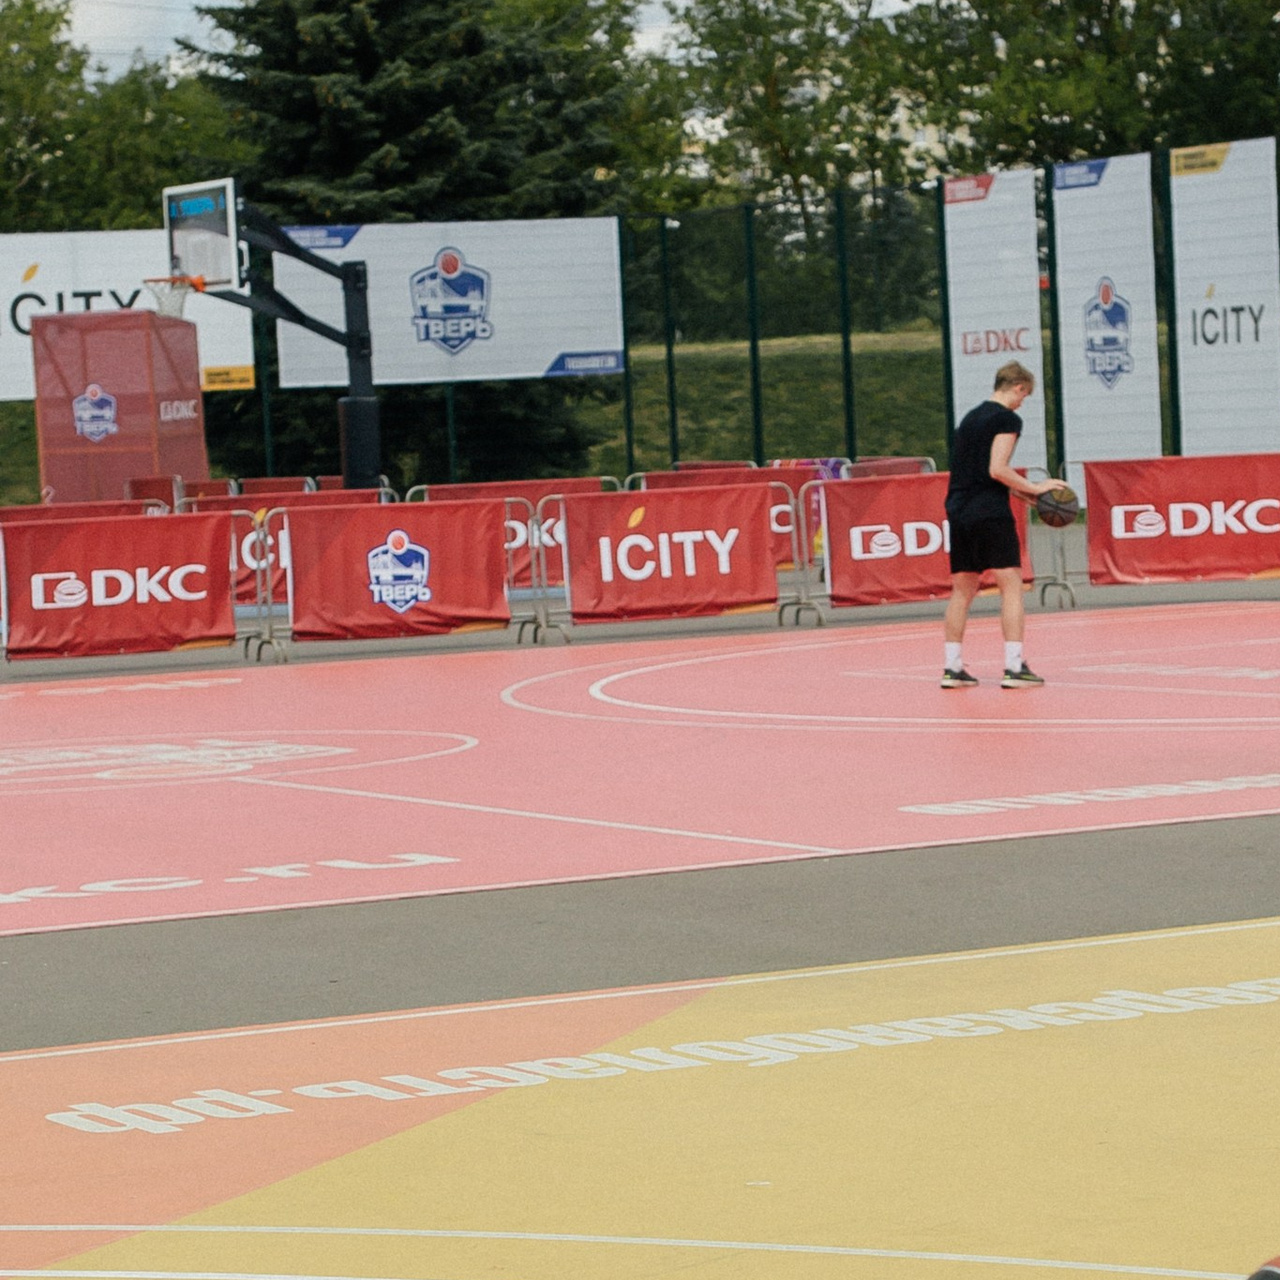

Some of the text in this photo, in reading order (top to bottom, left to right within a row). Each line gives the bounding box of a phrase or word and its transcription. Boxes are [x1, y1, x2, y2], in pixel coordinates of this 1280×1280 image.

[414, 317, 493, 340] ТВЕРЬ
[1192, 305, 1265, 346] ICITY
[599, 528, 739, 583] ICITY
[91, 563, 208, 607] DKC
[369, 582, 432, 604] ТВЕРЬ
